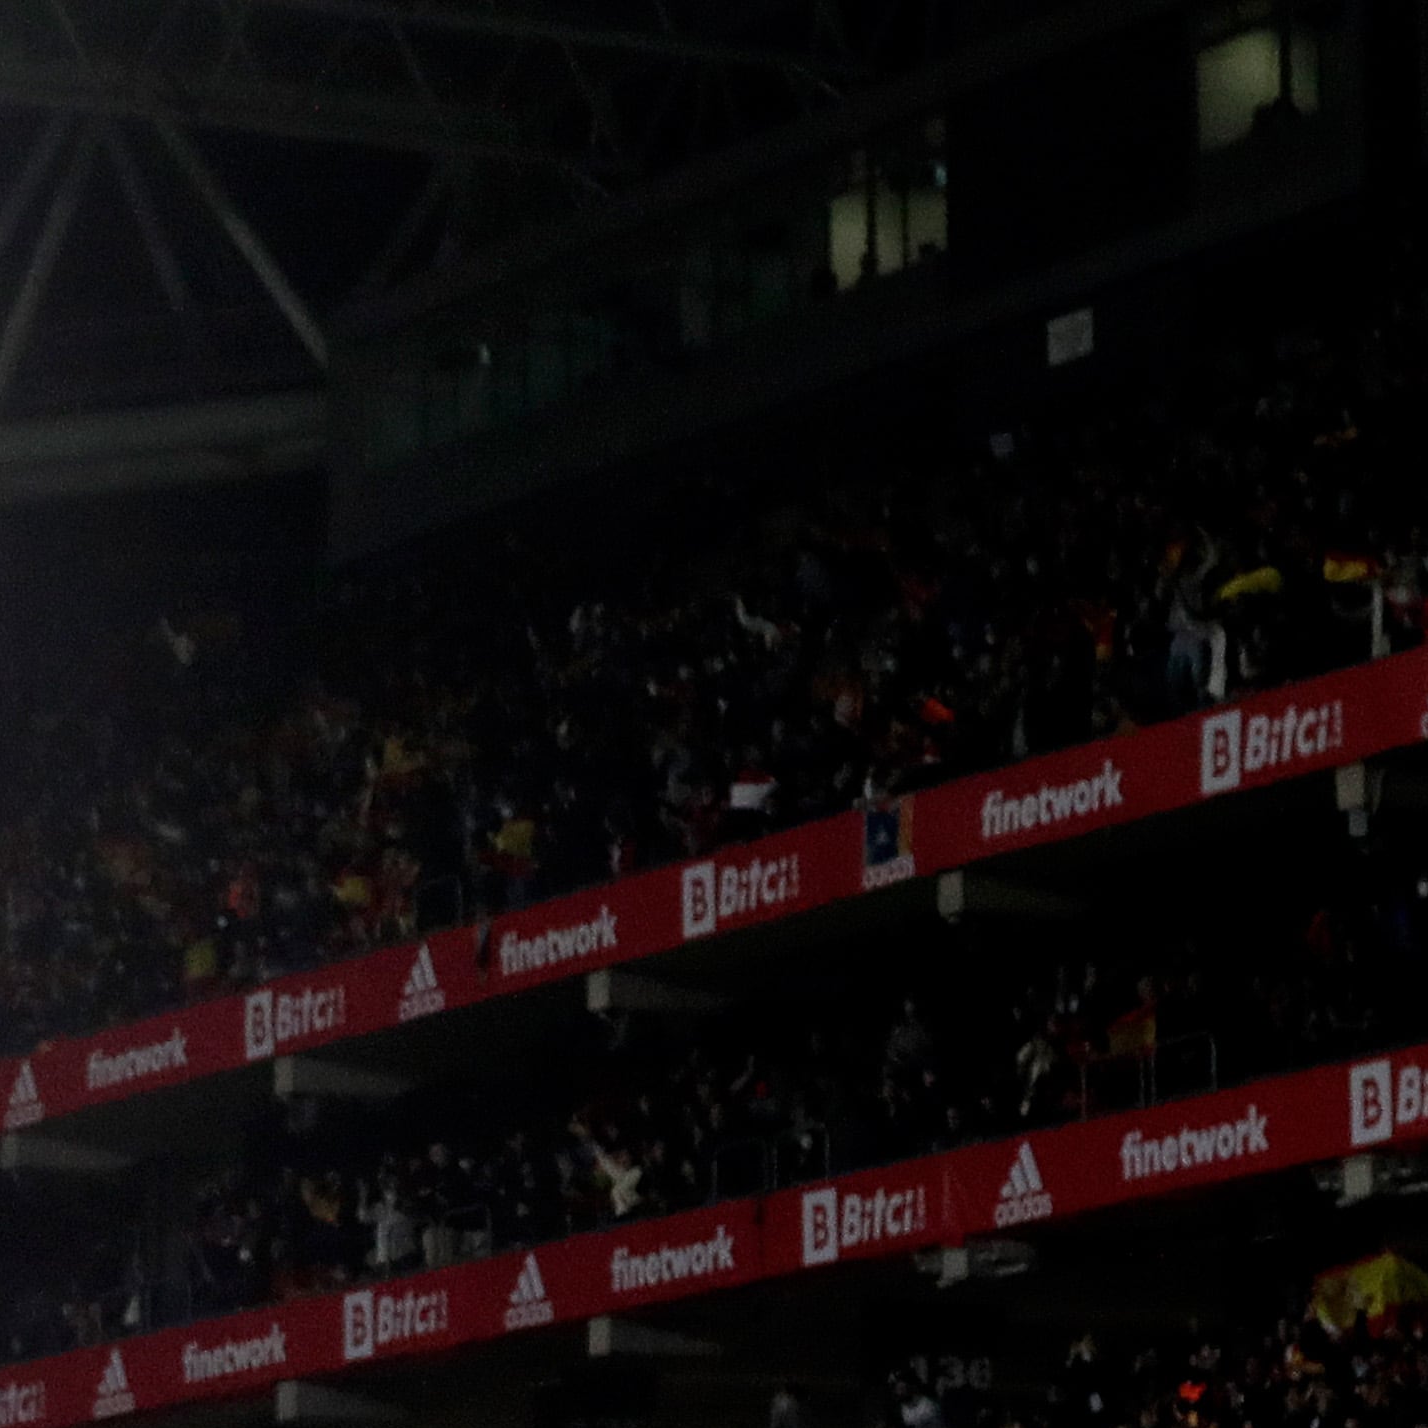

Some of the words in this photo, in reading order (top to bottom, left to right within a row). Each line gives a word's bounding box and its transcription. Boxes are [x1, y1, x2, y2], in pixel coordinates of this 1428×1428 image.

[1244, 706, 1329, 771] Bitci
[981, 760, 1122, 838] finetwork
[719, 858, 787, 916] Bitci
[499, 906, 617, 975] finetwork
[276, 989, 335, 1047] Bitci
[87, 1028, 187, 1089] finetwork
[1120, 1105, 1268, 1179] finetwork
[841, 1189, 913, 1246] Bitci
[611, 1226, 733, 1291] finetwork
[376, 1288, 437, 1345] Bitci
[182, 1324, 286, 1383] finetwork
